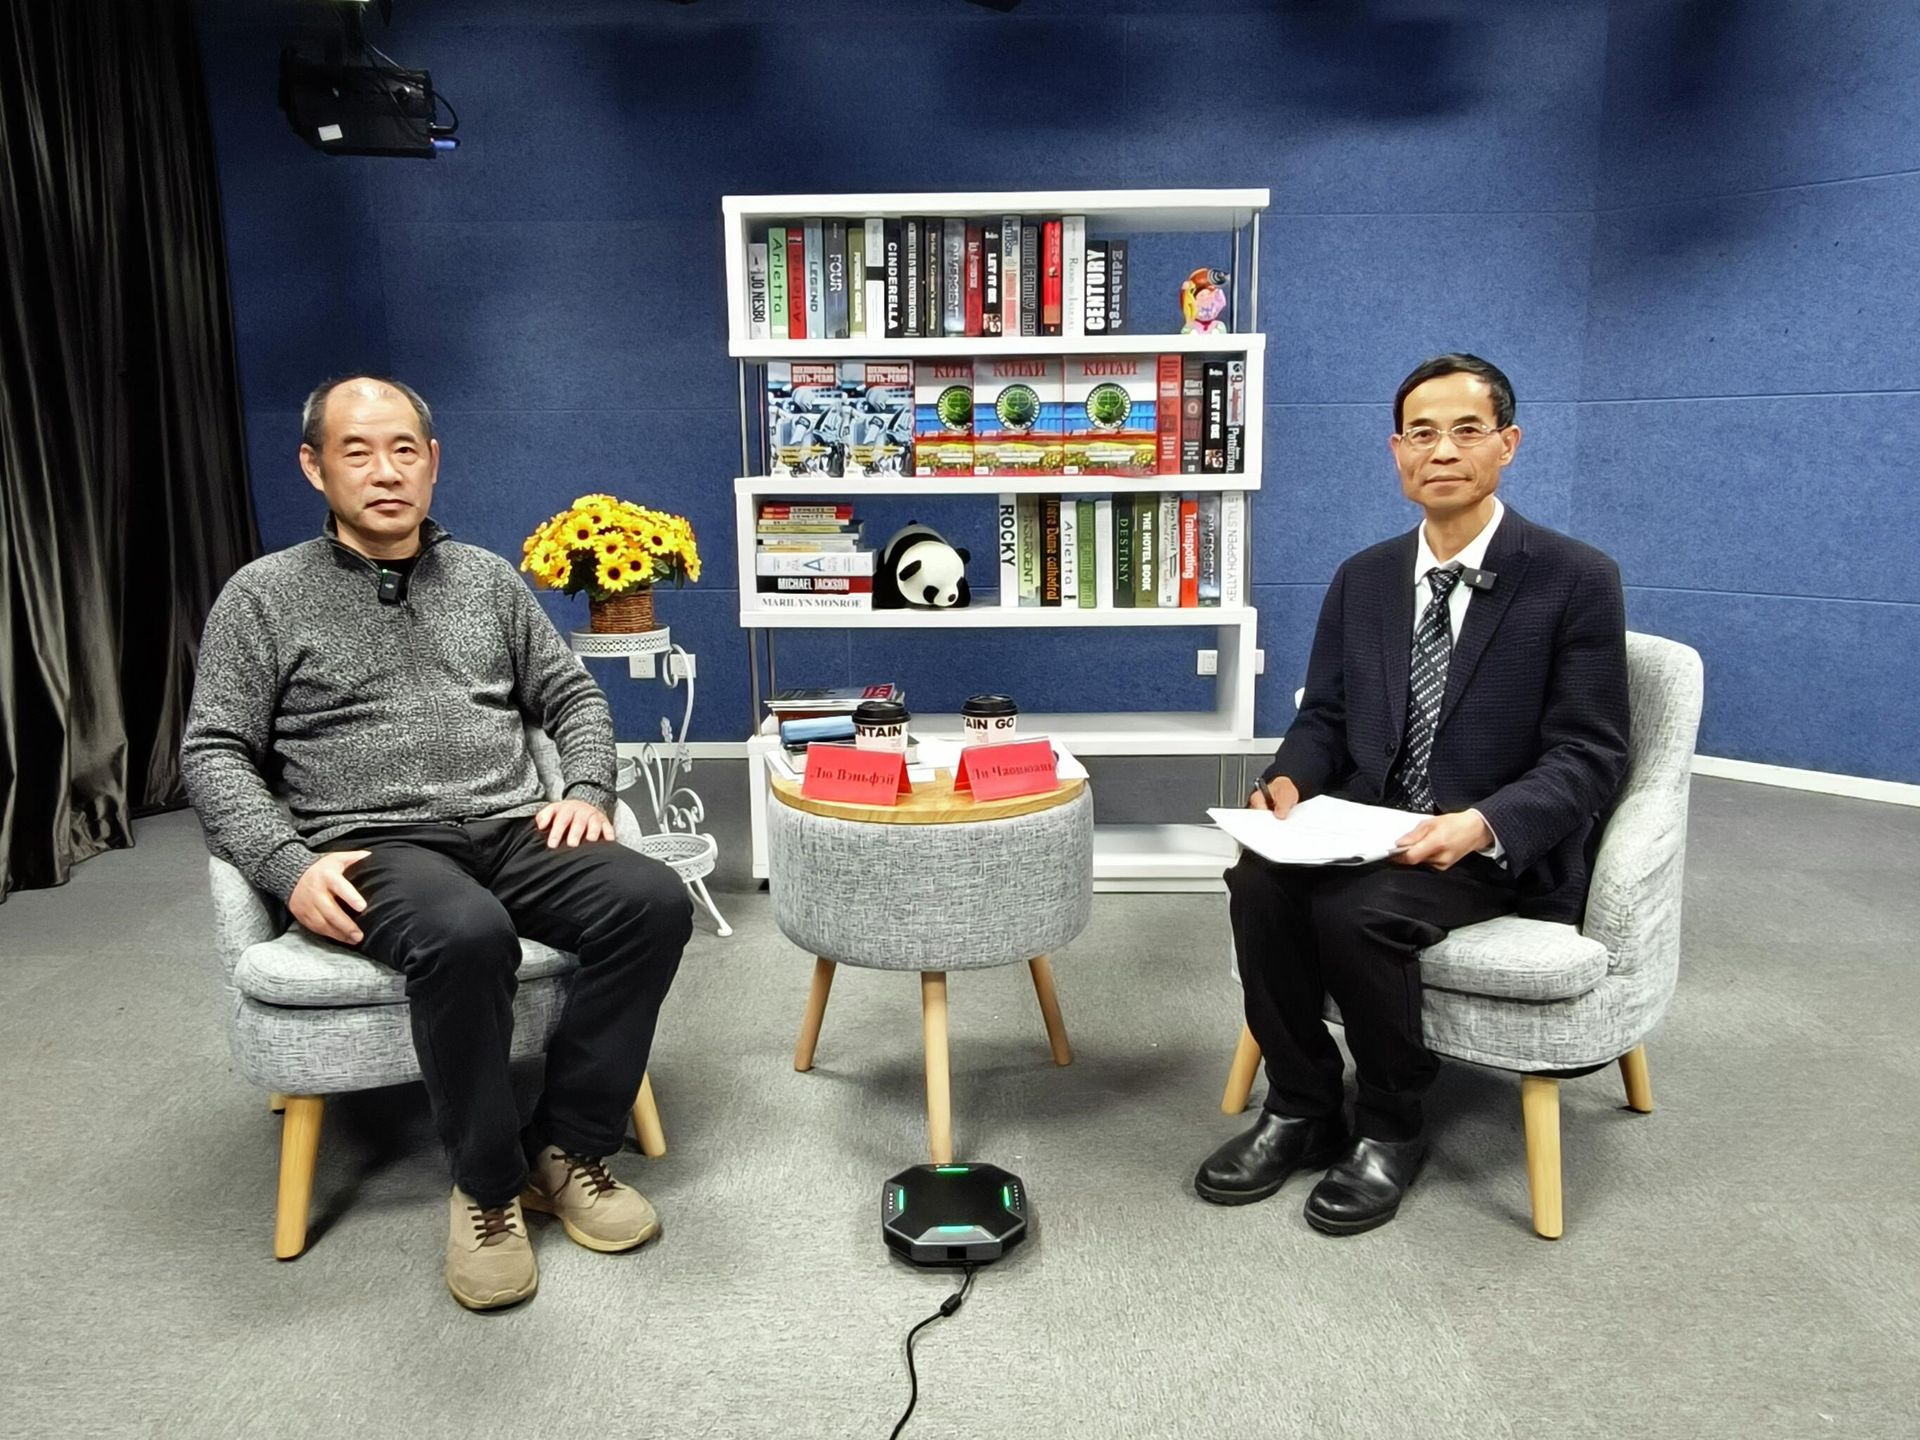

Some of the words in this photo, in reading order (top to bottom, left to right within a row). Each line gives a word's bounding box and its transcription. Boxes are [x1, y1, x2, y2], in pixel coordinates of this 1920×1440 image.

[751, 276, 765, 289] JO
[773, 238, 784, 314] Arletta
[829, 253, 842, 292] FOUR
[987, 253, 997, 273] LET
[987, 274, 997, 287] IT
[809, 261, 818, 313] LEGEND
[887, 242, 898, 330] CINDERELLA
[1086, 249, 1106, 331] CENTURY
[1109, 249, 1123, 329] Edinburgh
[751, 291, 765, 323] NESBO
[1210, 389, 1221, 410] LET
[1000, 504, 1016, 567] ROCKY
[1142, 511, 1152, 530] THE
[1023, 515, 1033, 585] INSURGENT
[1064, 520, 1074, 585] Arletta
[1119, 518, 1129, 583] DESTINY
[1142, 532, 1152, 563] HOTEL
[1182, 512, 1197, 579] Trainspotting
[1227, 529, 1238, 571] HOPPEN
[777, 578, 812, 590] MICHAEL
[1047, 556, 1060, 600] cathedral
[1142, 564, 1151, 591] BOOK
[1226, 573, 1237, 602] KELLY
[762, 597, 812, 608] MARILYN
[815, 599, 862, 609] MONROE
[995, 717, 1015, 729] GO
